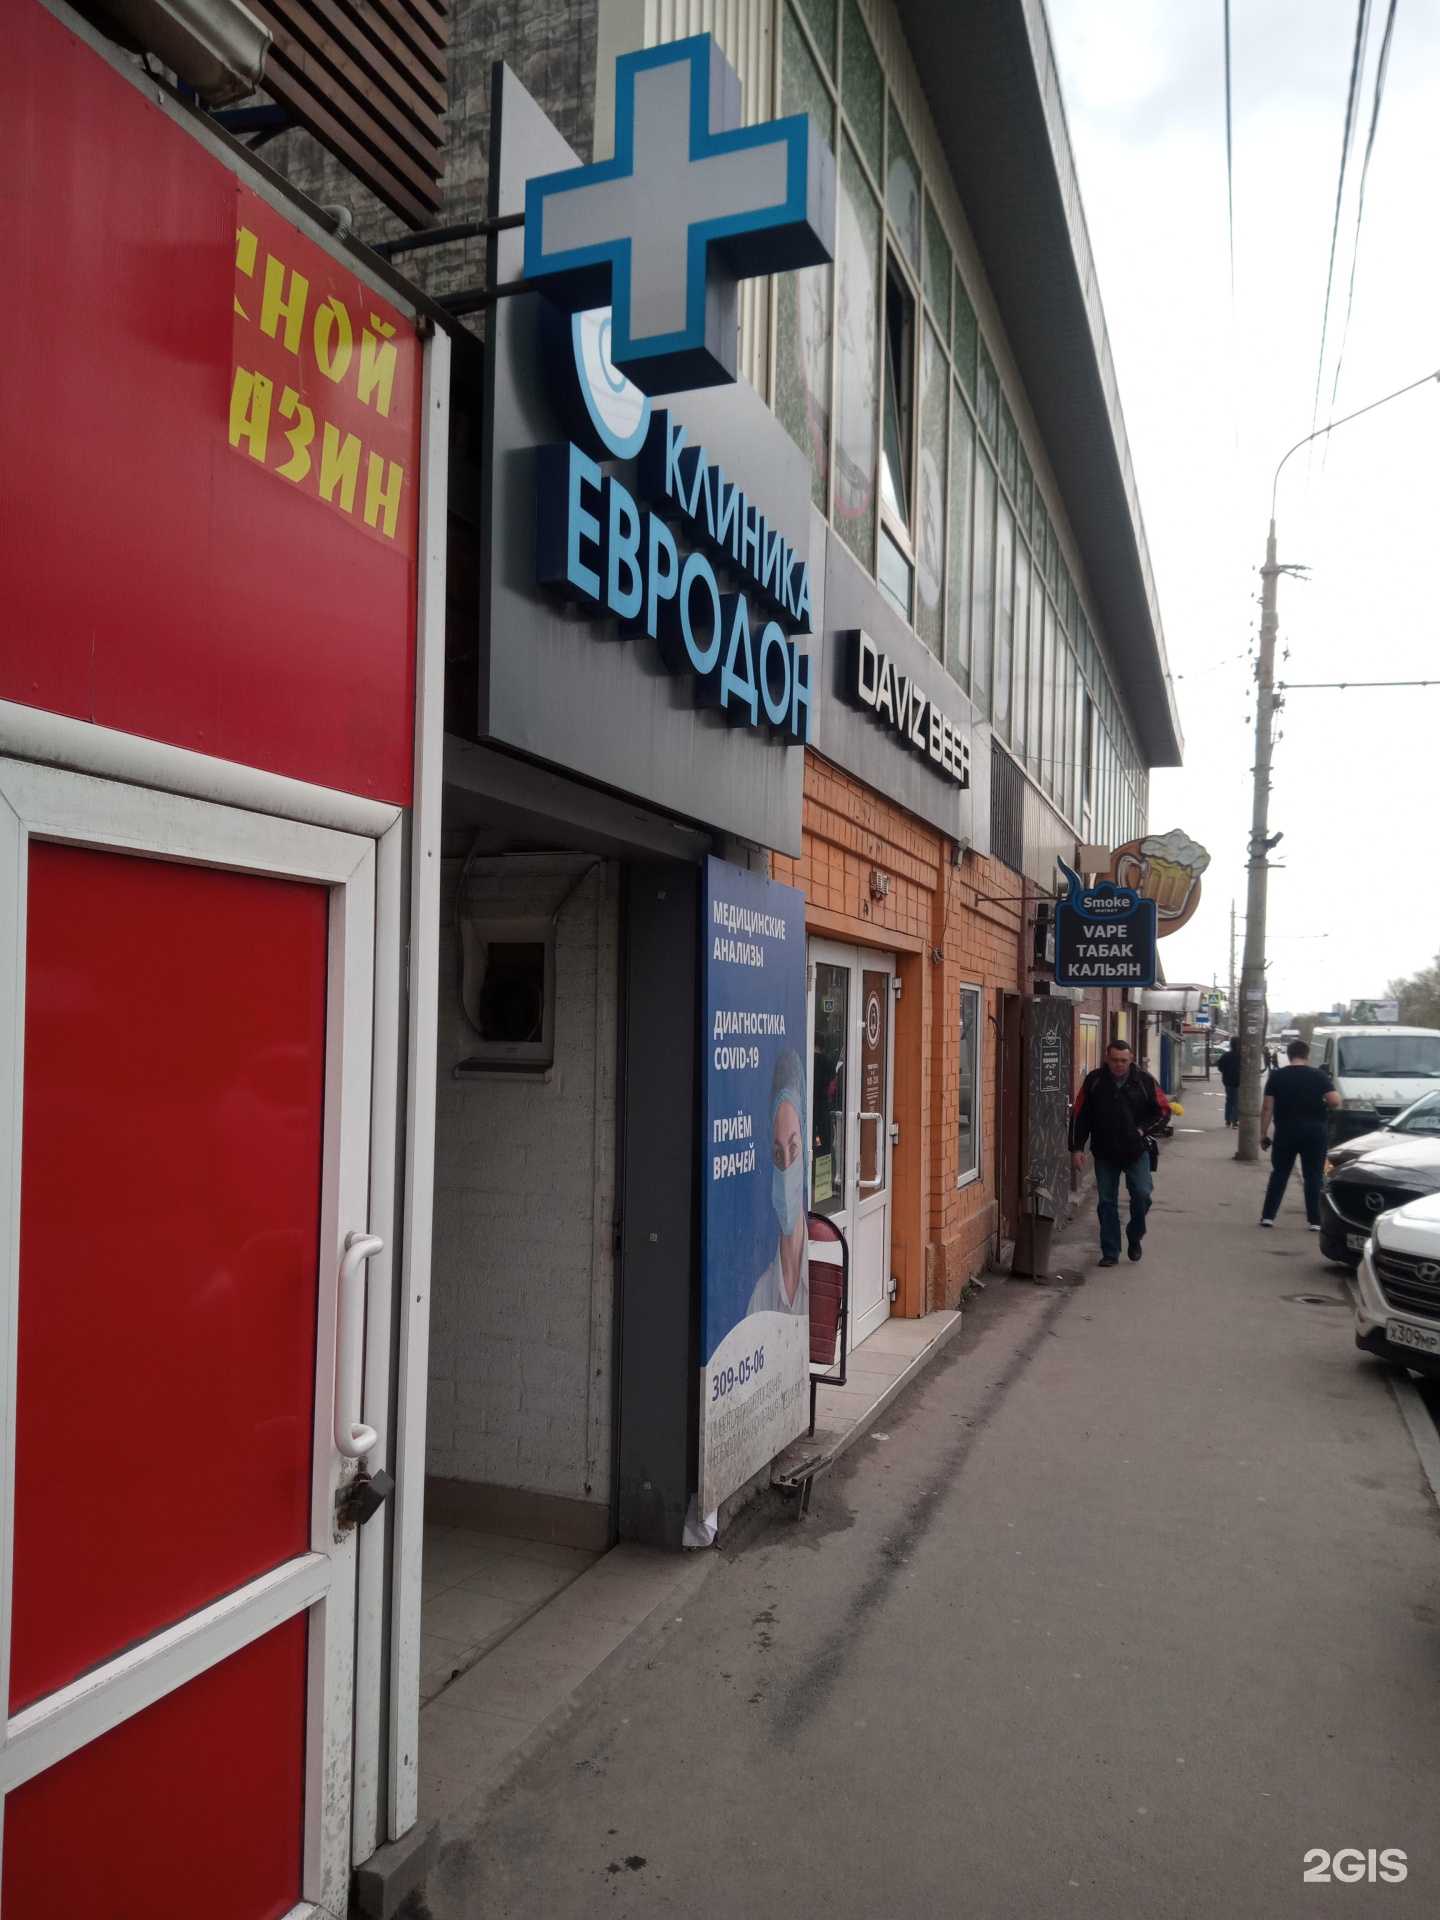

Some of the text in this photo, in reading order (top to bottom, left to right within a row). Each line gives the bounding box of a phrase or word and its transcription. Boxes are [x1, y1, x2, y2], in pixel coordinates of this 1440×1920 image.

[666, 420, 813, 632] КЛИНИКА
[567, 441, 812, 744] ЕВРОДОН
[858, 630, 972, 786] DAVIZ BEER
[1083, 897, 1130, 908] Smoke
[713, 901, 786, 941] МЕДИЦИНСКИЕ
[1083, 925, 1128, 938] VAPE
[713, 937, 764, 968] АНАЛИЗЫ
[1076, 944, 1133, 957] ТАБАК
[1068, 963, 1141, 976] КАЛЬЯН
[713, 1010, 786, 1040] ДИАГНОСТИКА
[714, 1047, 759, 1071] COVID-19
[713, 1110, 752, 1144] ПРИЁМ
[713, 1142, 756, 1181] ВРАЧЕЙ
[712, 1346, 764, 1402] 309-05-06
